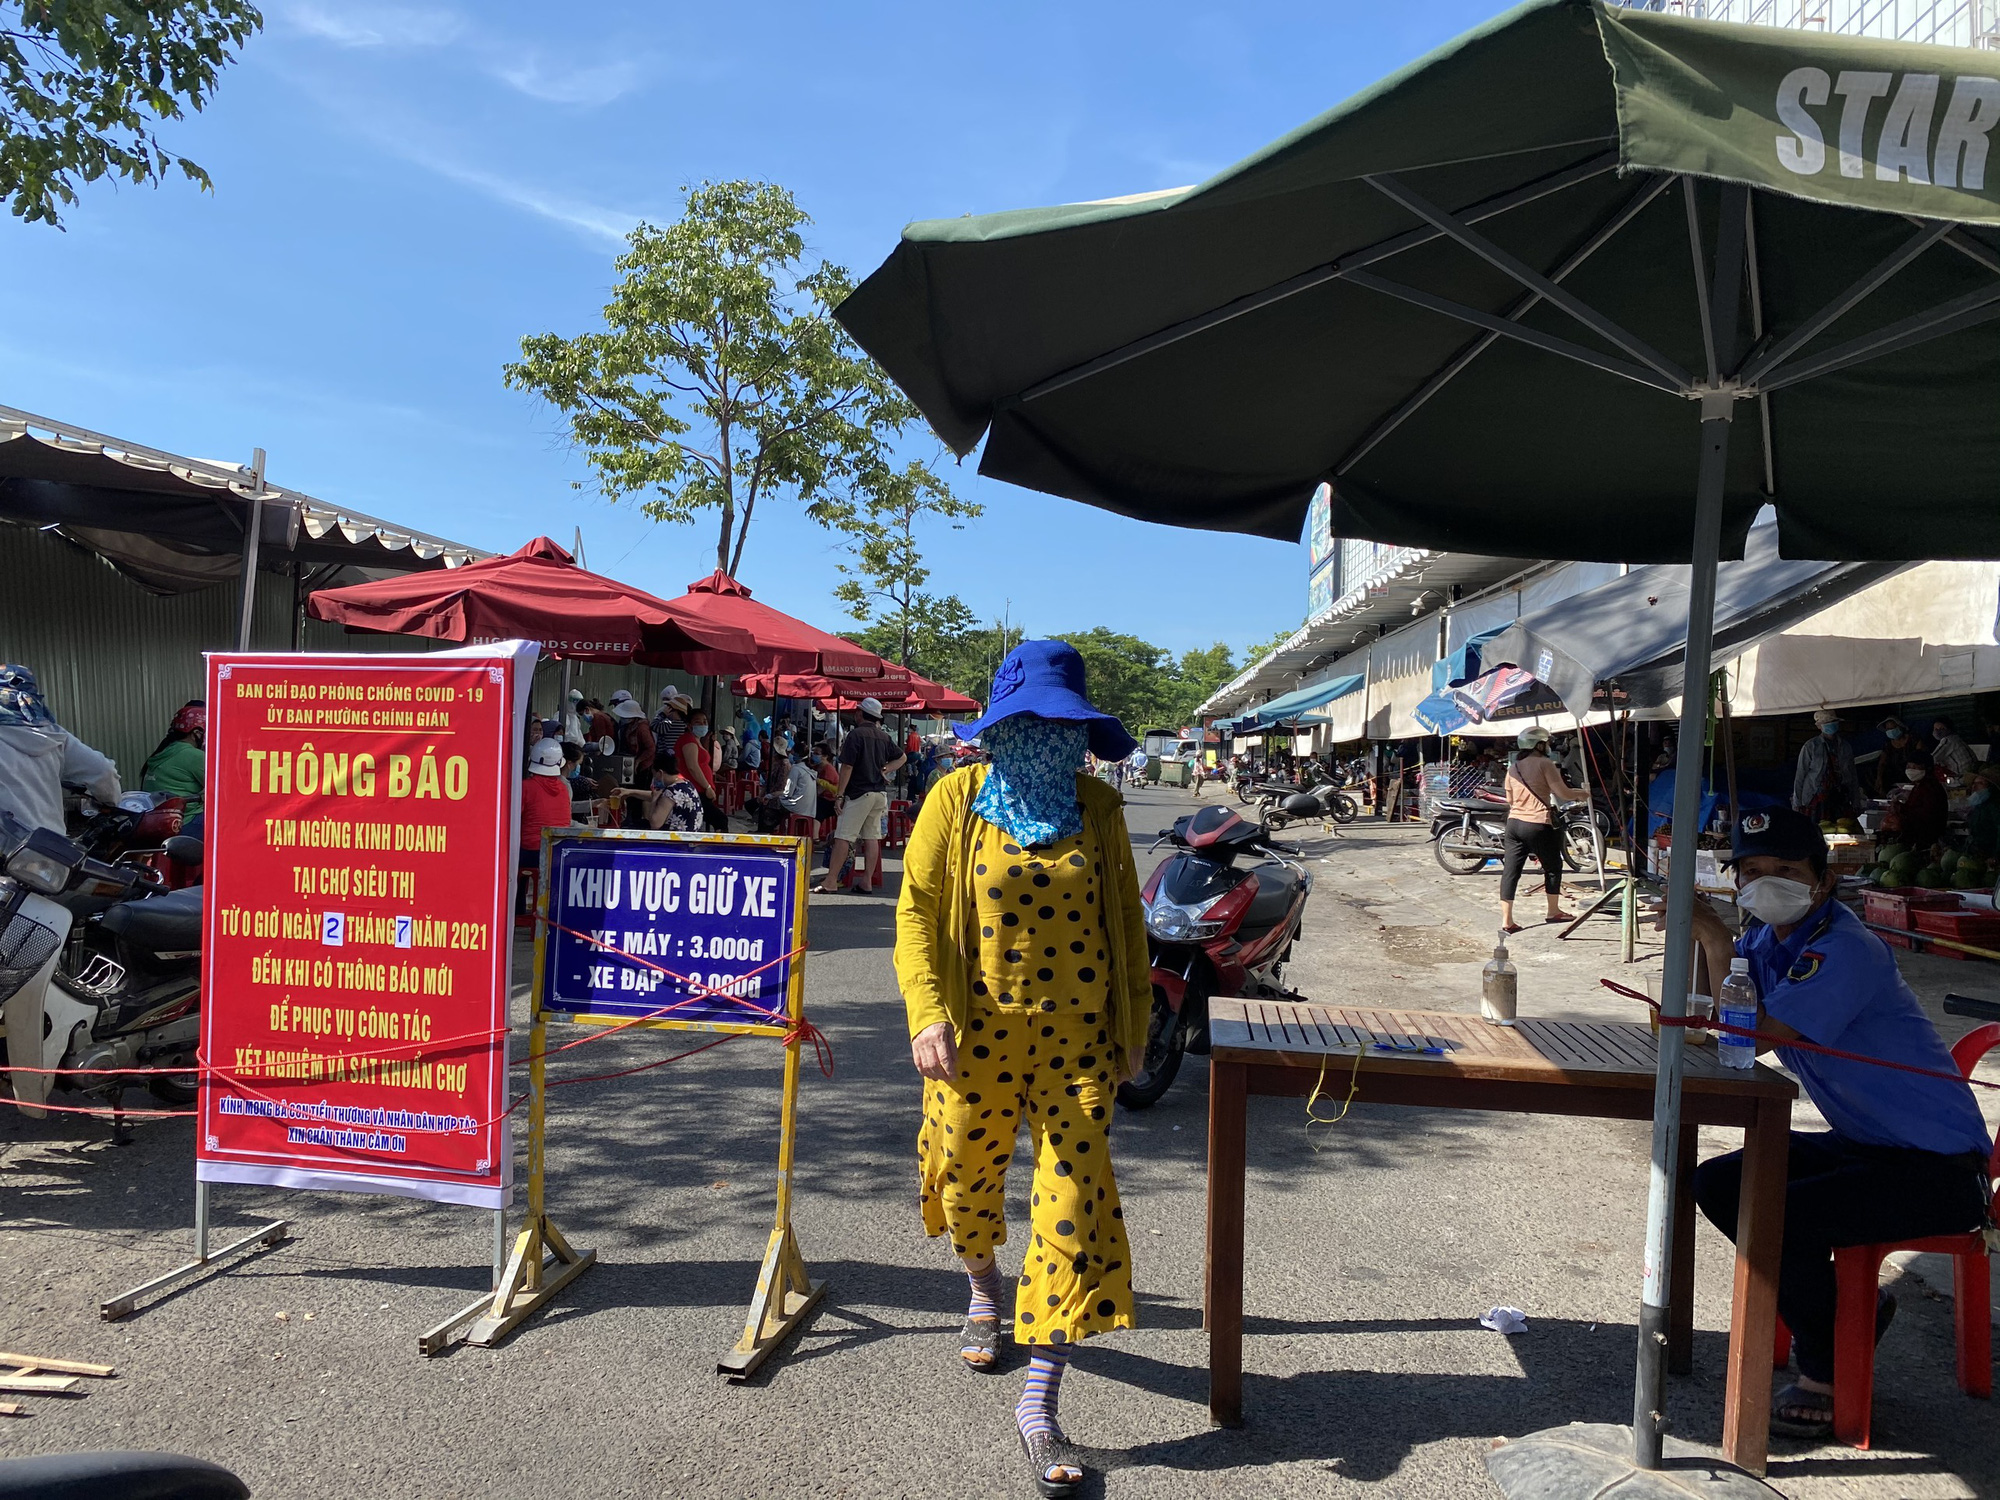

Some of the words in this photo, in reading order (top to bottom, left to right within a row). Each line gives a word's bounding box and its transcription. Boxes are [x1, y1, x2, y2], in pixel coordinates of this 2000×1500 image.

[572, 641, 630, 651] COFFEE
[237, 683, 263, 699] BAN
[266, 680, 288, 699] CHỈ
[290, 684, 316, 702] ĐẠO
[319, 682, 364, 701] PHÒNG
[367, 681, 412, 701] CHỐNG
[415, 686, 455, 702] COVID
[467, 687, 484, 702] 19
[267, 703, 284, 723] ỦY
[286, 708, 313, 724] BAN
[316, 706, 369, 725] PHƯỜNG
[372, 708, 414, 726] CHÍNH
[416, 709, 449, 727] GIÁN
[246, 742, 376, 797] THÔNG
[388, 745, 469, 800] BÁO
[265, 818, 297, 852] TẠM
[299, 815, 351, 849] NGỪNG
[355, 822, 391, 850] KINH
[395, 824, 447, 853] DOANH
[293, 866, 316, 899] TẠI
[320, 866, 350, 901] CHỢ
[353, 864, 387, 898] SIÊU
[391, 871, 415, 905] THỊ
[568, 867, 622, 910] KHU
[629, 867, 681, 921] VỰC
[688, 866, 739, 916] GIỮ
[740, 875, 778, 918] XE
[221, 904, 241, 936] TỪ
[254, 905, 280, 938] GIỜ
[282, 907, 322, 940] NGÀY
[326, 917, 340, 939] 2
[346, 911, 396, 945] THÁNG
[397, 919, 410, 943] 7
[412, 914, 448, 948] NĂM
[450, 921, 487, 951] 2021
[589, 929, 617, 953] XE
[623, 928, 672, 957] MÁY
[689, 935, 764, 961] 3.000đ
[252, 949, 282, 985] ĐẾN
[285, 958, 310, 986] KHI
[313, 955, 333, 988] CÓ
[336, 957, 386, 992] THÔNG
[389, 960, 420, 994] BÁO
[423, 962, 453, 996] MỚI
[587, 965, 615, 989] XE
[620, 967, 665, 996] ĐẠP
[687, 972, 762, 999] 2.000đ
[270, 994, 289, 1032] ĐỂ
[292, 1005, 332, 1040] PHỤC
[335, 1008, 355, 1042] VỤ
[358, 1005, 399, 1040] CÔNG
[402, 1008, 432, 1042] TÁC
[234, 1043, 262, 1076] XÉT
[265, 1047, 324, 1085] NGHIỆM
[327, 1049, 346, 1082] VÀ
[349, 1054, 378, 1085] SÁT
[436, 1062, 468, 1099] CHỢ
[219, 1095, 243, 1115] KÍNH
[244, 1099, 273, 1117] MONG
[289, 1103, 309, 1121] CON
[371, 1106, 385, 1127] VÀ
[386, 1108, 414, 1129] NHÂN
[415, 1110, 436, 1132] DÂN
[287, 1126, 306, 1144] XIN
[306, 1125, 334, 1146] CHÂN
[334, 1128, 367, 1149] THÀNH
[367, 1130, 391, 1151] CẢM
[391, 1134, 406, 1153] ƠN
